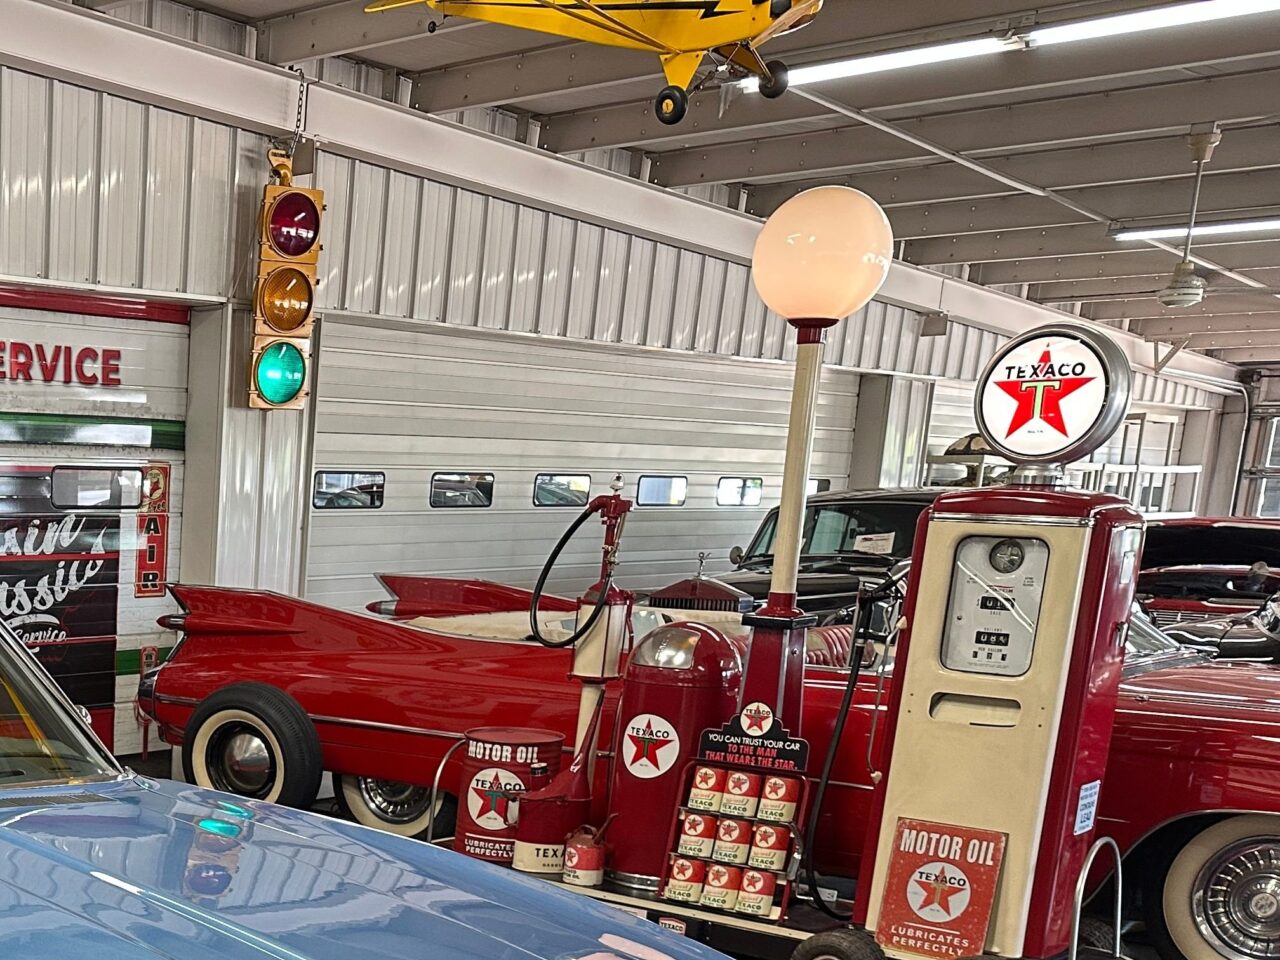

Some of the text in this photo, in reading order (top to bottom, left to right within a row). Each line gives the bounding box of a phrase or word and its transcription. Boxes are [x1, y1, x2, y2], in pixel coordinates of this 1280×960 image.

[1005, 361, 1086, 379] TEXACO
[142, 516, 161, 590] AIR
[745, 708, 771, 716] TEXACO
[631, 726, 670, 739] TEXACO
[708, 733, 800, 751] YOU CAN TRUST YOUR CAR
[468, 740, 539, 763] MOTOR OIL
[728, 744, 777, 757] TO THE MAN
[705, 751, 725, 761] THAT
[726, 753, 755, 766] WEARS
[758, 757, 773, 767] THE
[475, 778, 522, 792] TEXACO
[464, 838, 515, 851] LUBRICATE
[465, 847, 514, 858] PERFECTLY
[900, 828, 995, 866] MOTOR OIL
[918, 870, 967, 887] TEXACO
[660, 920, 684, 933] TEXACO
[891, 925, 969, 947] LUBRICATES
[892, 935, 964, 957] PERFECTLY
